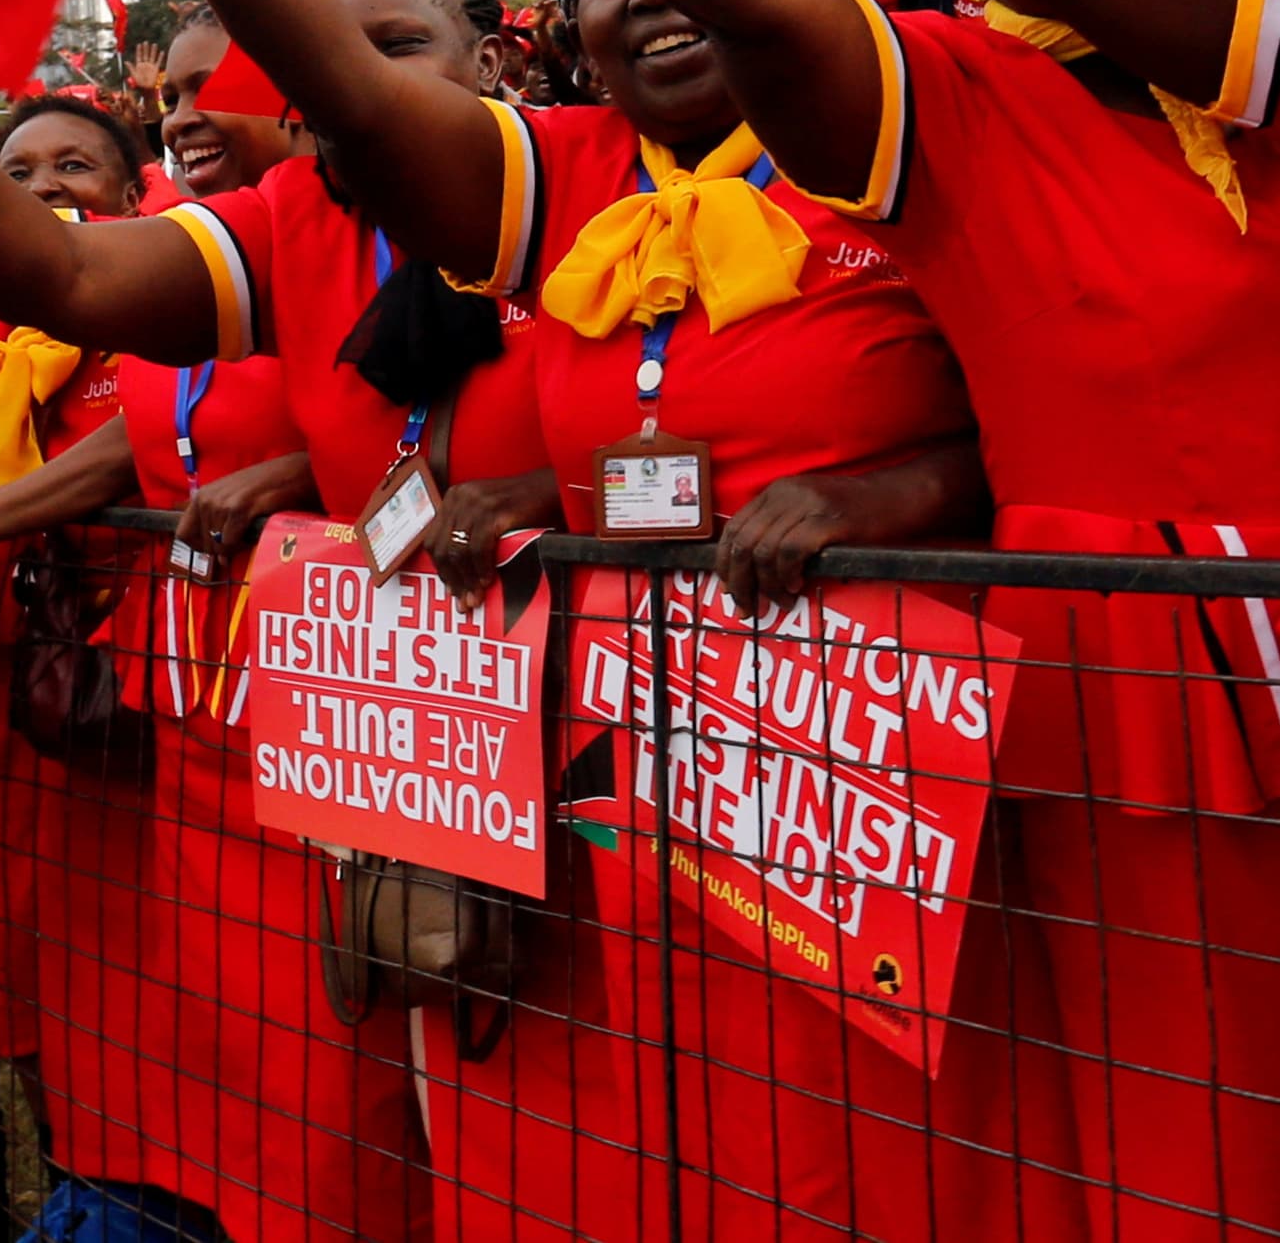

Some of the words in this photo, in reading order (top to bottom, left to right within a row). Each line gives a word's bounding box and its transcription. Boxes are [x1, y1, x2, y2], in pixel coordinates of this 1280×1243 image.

[82, 374, 118, 401] Jubi
[308, 565, 377, 624] JOB
[265, 614, 397, 684] FINISH
[412, 633, 523, 708] LET'S
[623, 589, 723, 688] ARE
[732, 639, 908, 787] BUILT.
[291, 689, 416, 763] BUILT.
[426, 711, 507, 781] ARE
[256, 742, 537, 851] FOUNDATIONS
[742, 736, 942, 903] FINISH
[750, 817, 858, 925] JOB
